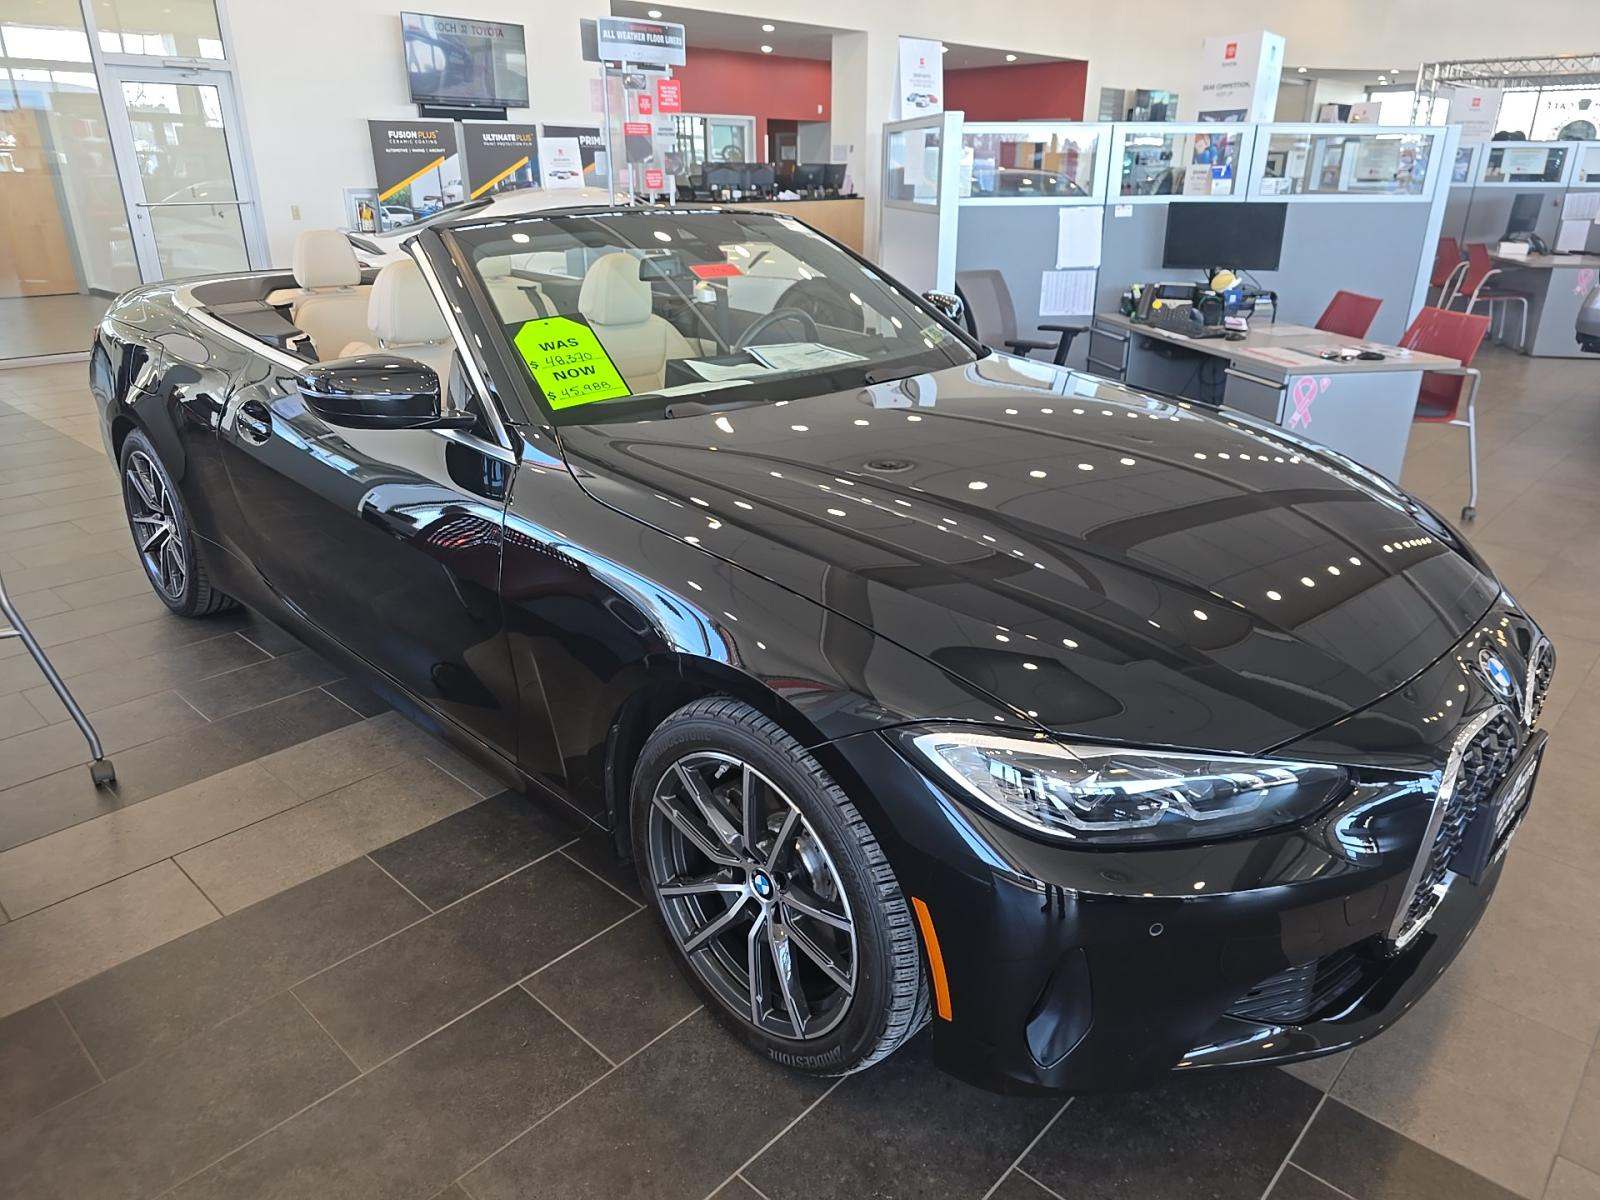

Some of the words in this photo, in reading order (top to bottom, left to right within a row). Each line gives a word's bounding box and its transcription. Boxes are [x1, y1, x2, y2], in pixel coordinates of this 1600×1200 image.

[471, 25, 505, 39] TOYOTA
[602, 29, 616, 38] ALL
[616, 30, 646, 42] WEATHER
[646, 33, 665, 44] FLOOR
[579, 135, 602, 146] PRIM
[538, 338, 579, 352] WAS
[530, 360, 540, 370] $
[553, 365, 596, 381] NOW
[547, 391, 557, 401] $
